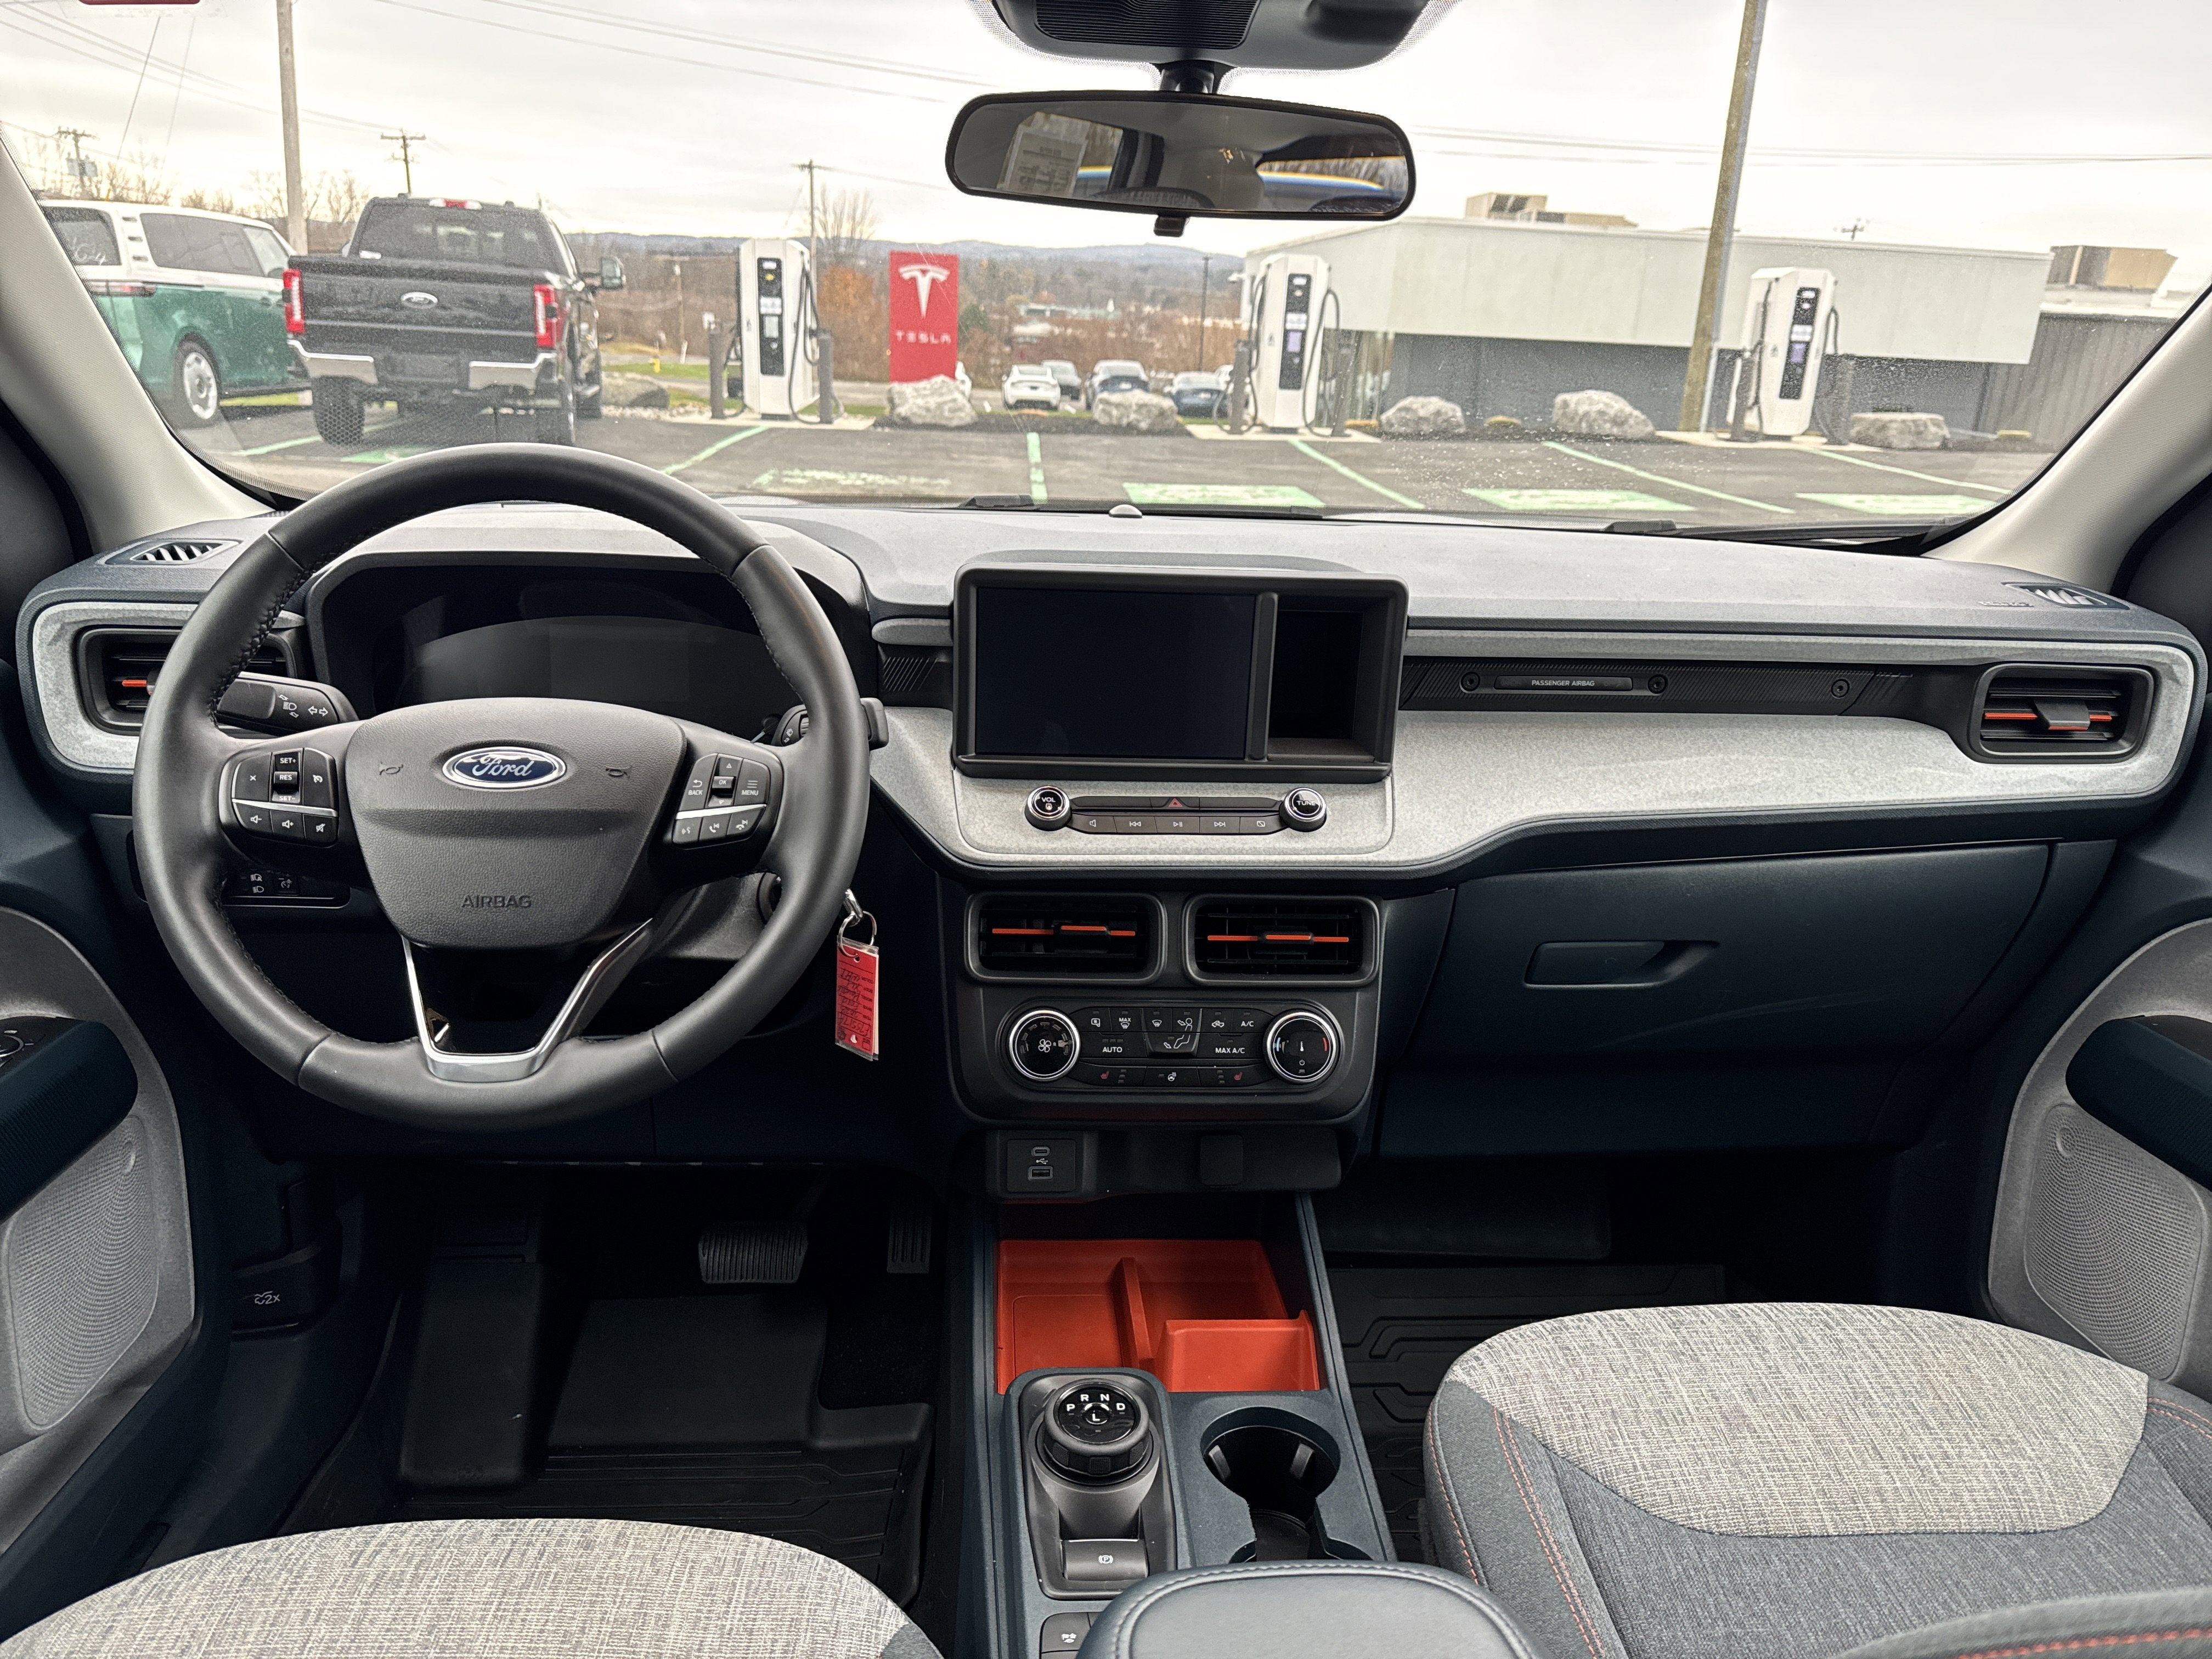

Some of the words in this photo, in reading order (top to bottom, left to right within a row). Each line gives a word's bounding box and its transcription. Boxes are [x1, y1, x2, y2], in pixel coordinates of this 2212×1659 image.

[895, 330, 951, 344] TESLA
[472, 754, 534, 776] Ford
[461, 895, 532, 908] AIRBAG
[1066, 1403, 1075, 1412] P
[1116, 1402, 1126, 1410] D
[1092, 1413, 1101, 1421] L
